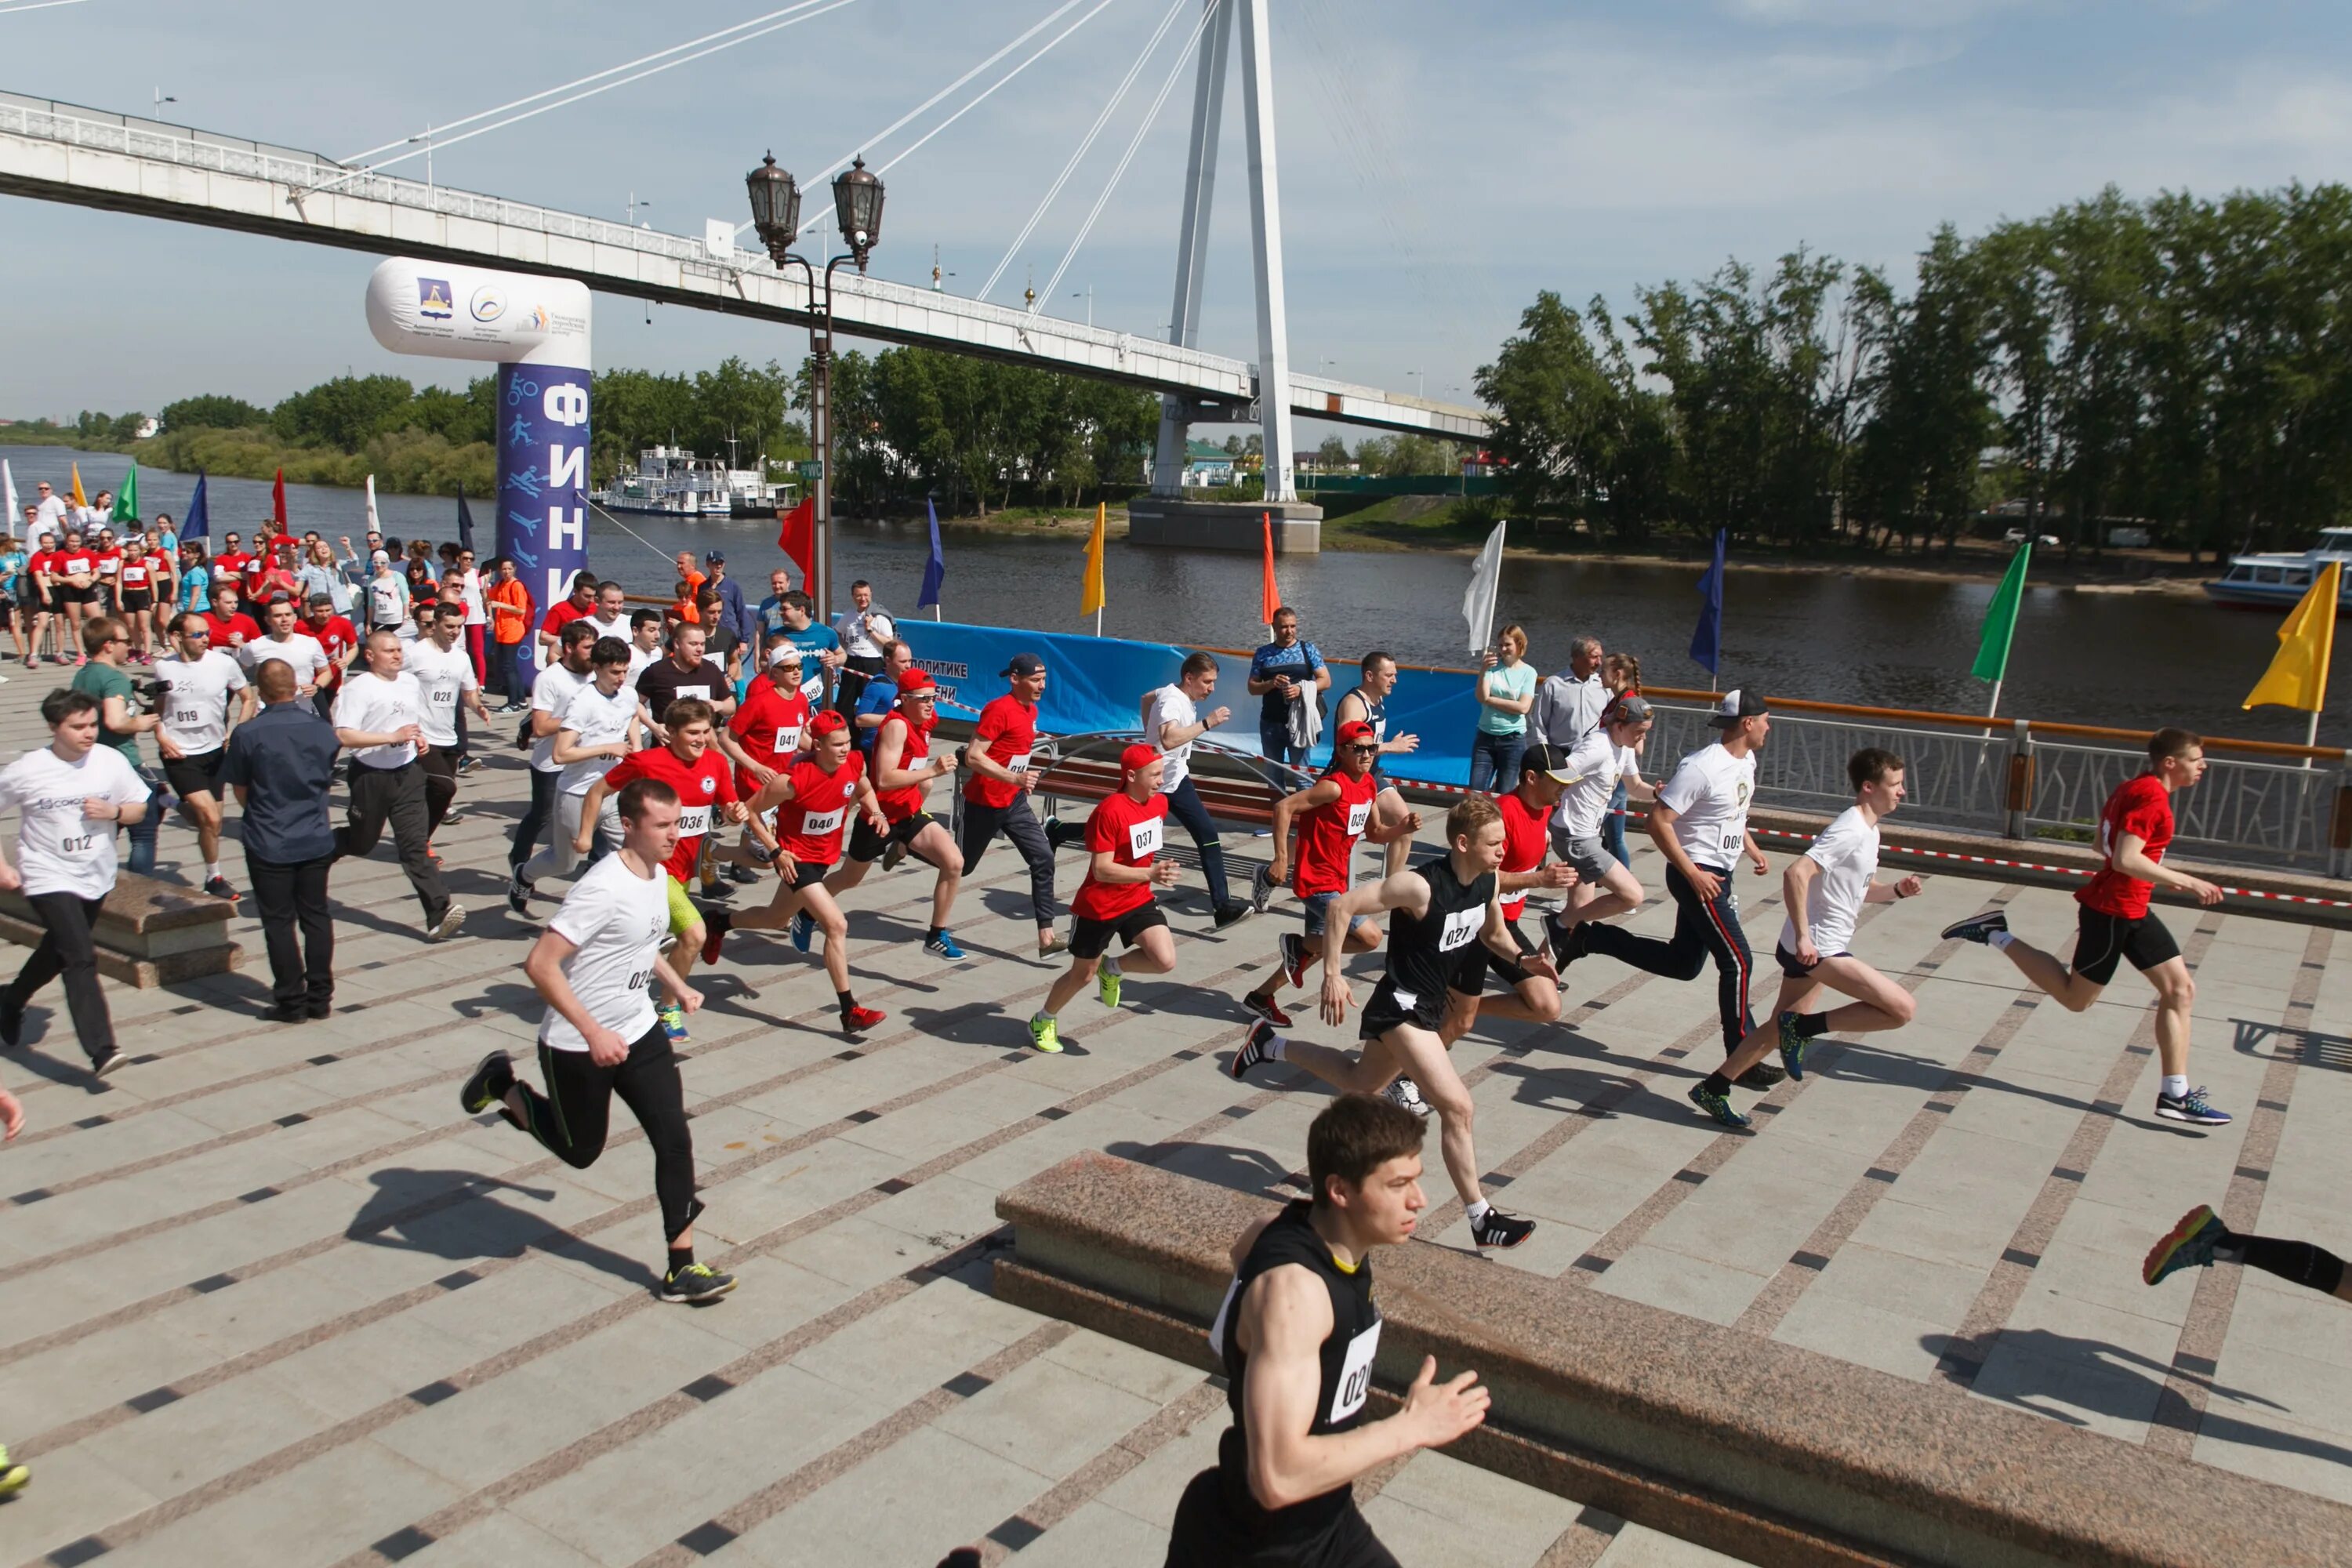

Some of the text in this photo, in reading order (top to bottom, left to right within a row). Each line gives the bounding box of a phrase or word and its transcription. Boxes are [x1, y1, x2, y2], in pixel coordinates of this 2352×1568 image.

[808, 463, 822, 477] WC
[533, 382, 588, 671] ФИНИ
[911, 659, 967, 678] ПОЛИТИКЕ
[807, 685, 821, 699] 090
[935, 685, 956, 701] ЕНИ
[177, 710, 198, 722] 019
[779, 735, 796, 746] 041
[680, 815, 703, 829] 036
[808, 817, 834, 829] 040
[1351, 812, 1366, 827] 039
[63, 834, 93, 852] 012
[1136, 830, 1152, 849] 037
